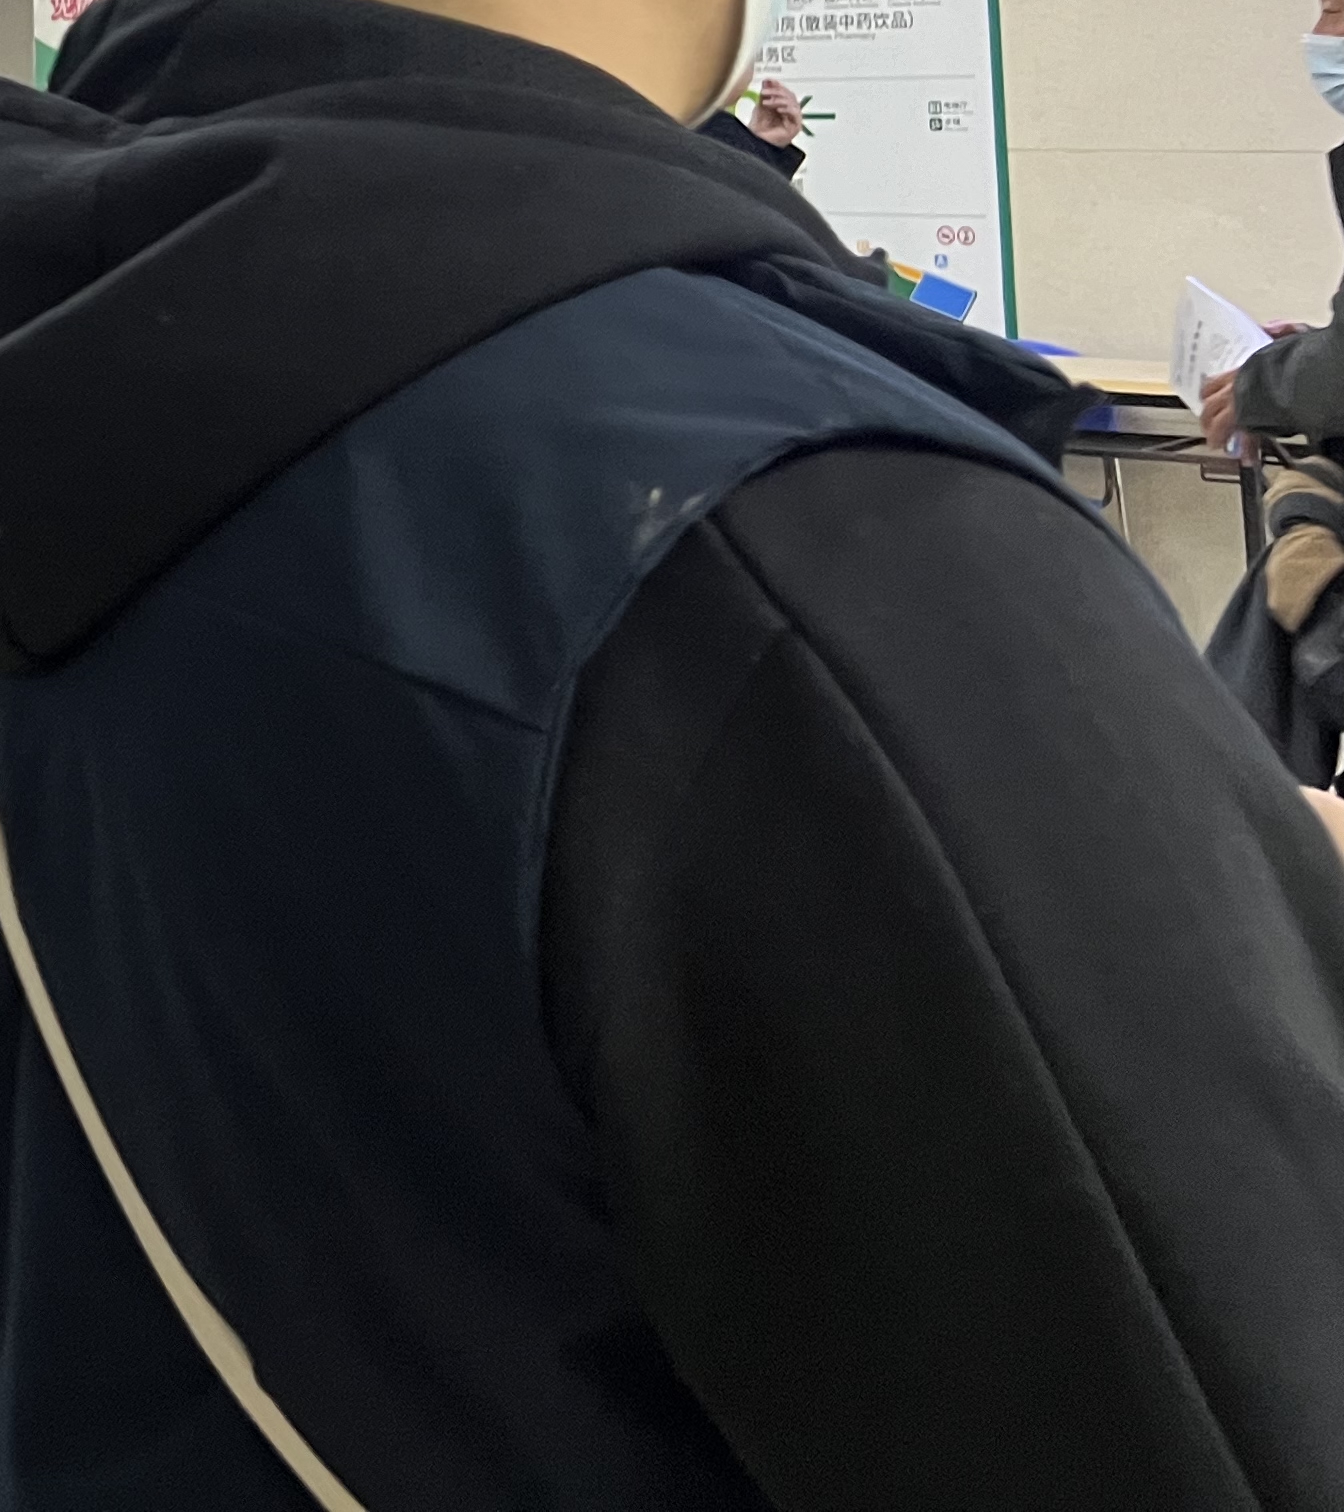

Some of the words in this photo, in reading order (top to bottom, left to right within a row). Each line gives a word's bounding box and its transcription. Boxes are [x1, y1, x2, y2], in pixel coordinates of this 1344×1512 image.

[775, 10, 914, 33] 房(散装中药饮品)
